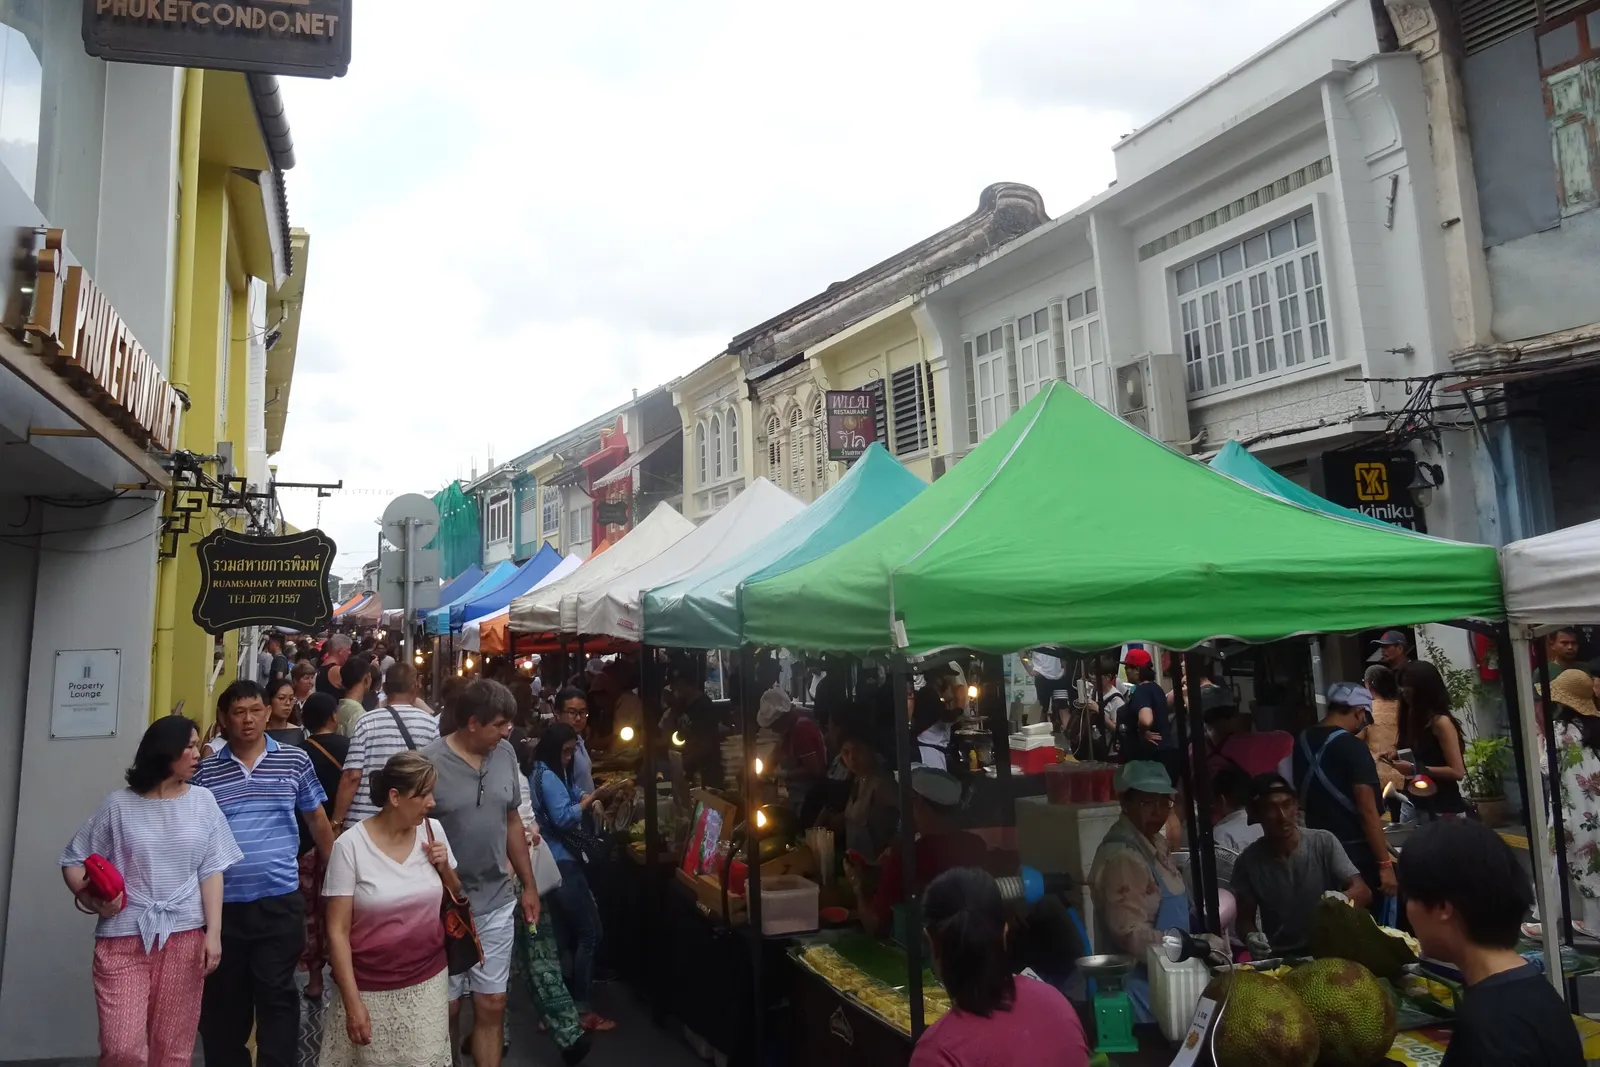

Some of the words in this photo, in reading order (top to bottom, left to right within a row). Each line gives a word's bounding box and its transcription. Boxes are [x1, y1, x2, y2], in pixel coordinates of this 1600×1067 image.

[96, 0, 339, 37] PHUKETCONDO.NET
[832, 395, 870, 409] WILAI
[213, 554, 320, 571] รวมสหายการพิมพ์
[213, 579, 275, 588] RUAMSAHARY
[277, 579, 317, 588] PRINTING
[269, 594, 301, 604] 211557
[68, 682, 104, 690] Property
